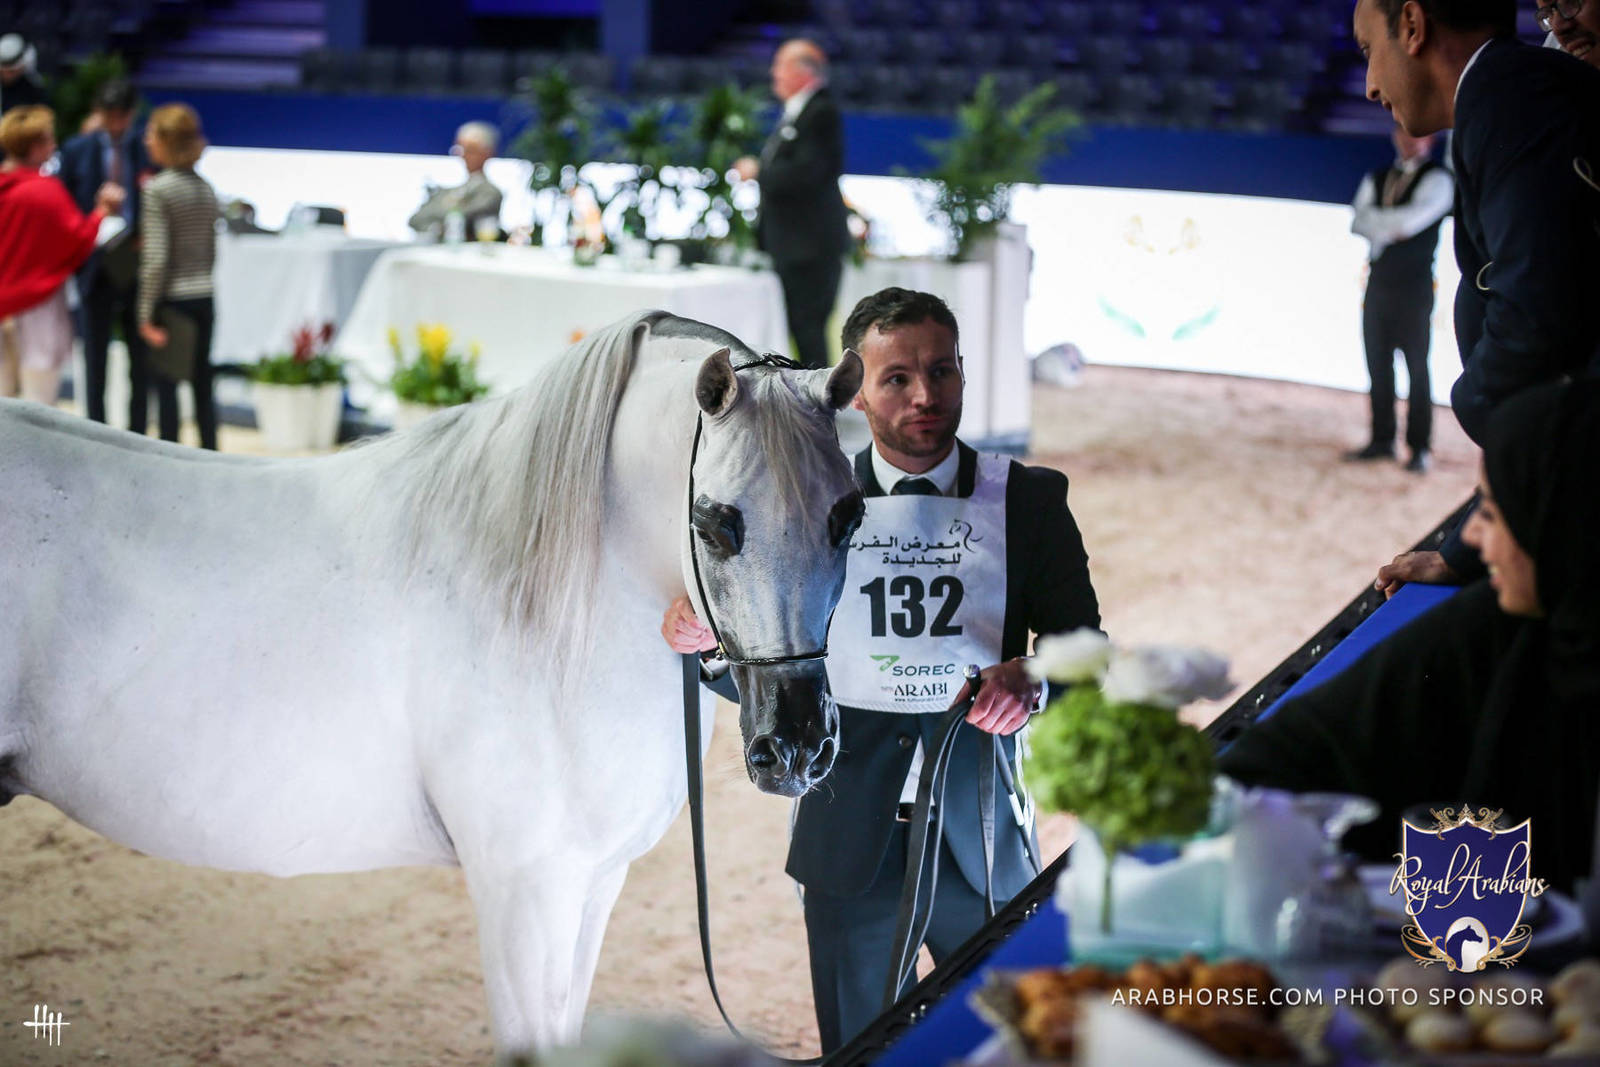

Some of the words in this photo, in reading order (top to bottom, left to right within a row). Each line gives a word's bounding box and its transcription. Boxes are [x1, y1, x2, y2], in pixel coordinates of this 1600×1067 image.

[901, 536, 960, 551] معرض
[882, 552, 961, 568] للجديدة
[860, 575, 964, 638] 132
[892, 663, 956, 677] SOREC
[894, 682, 947, 697] ARABI
